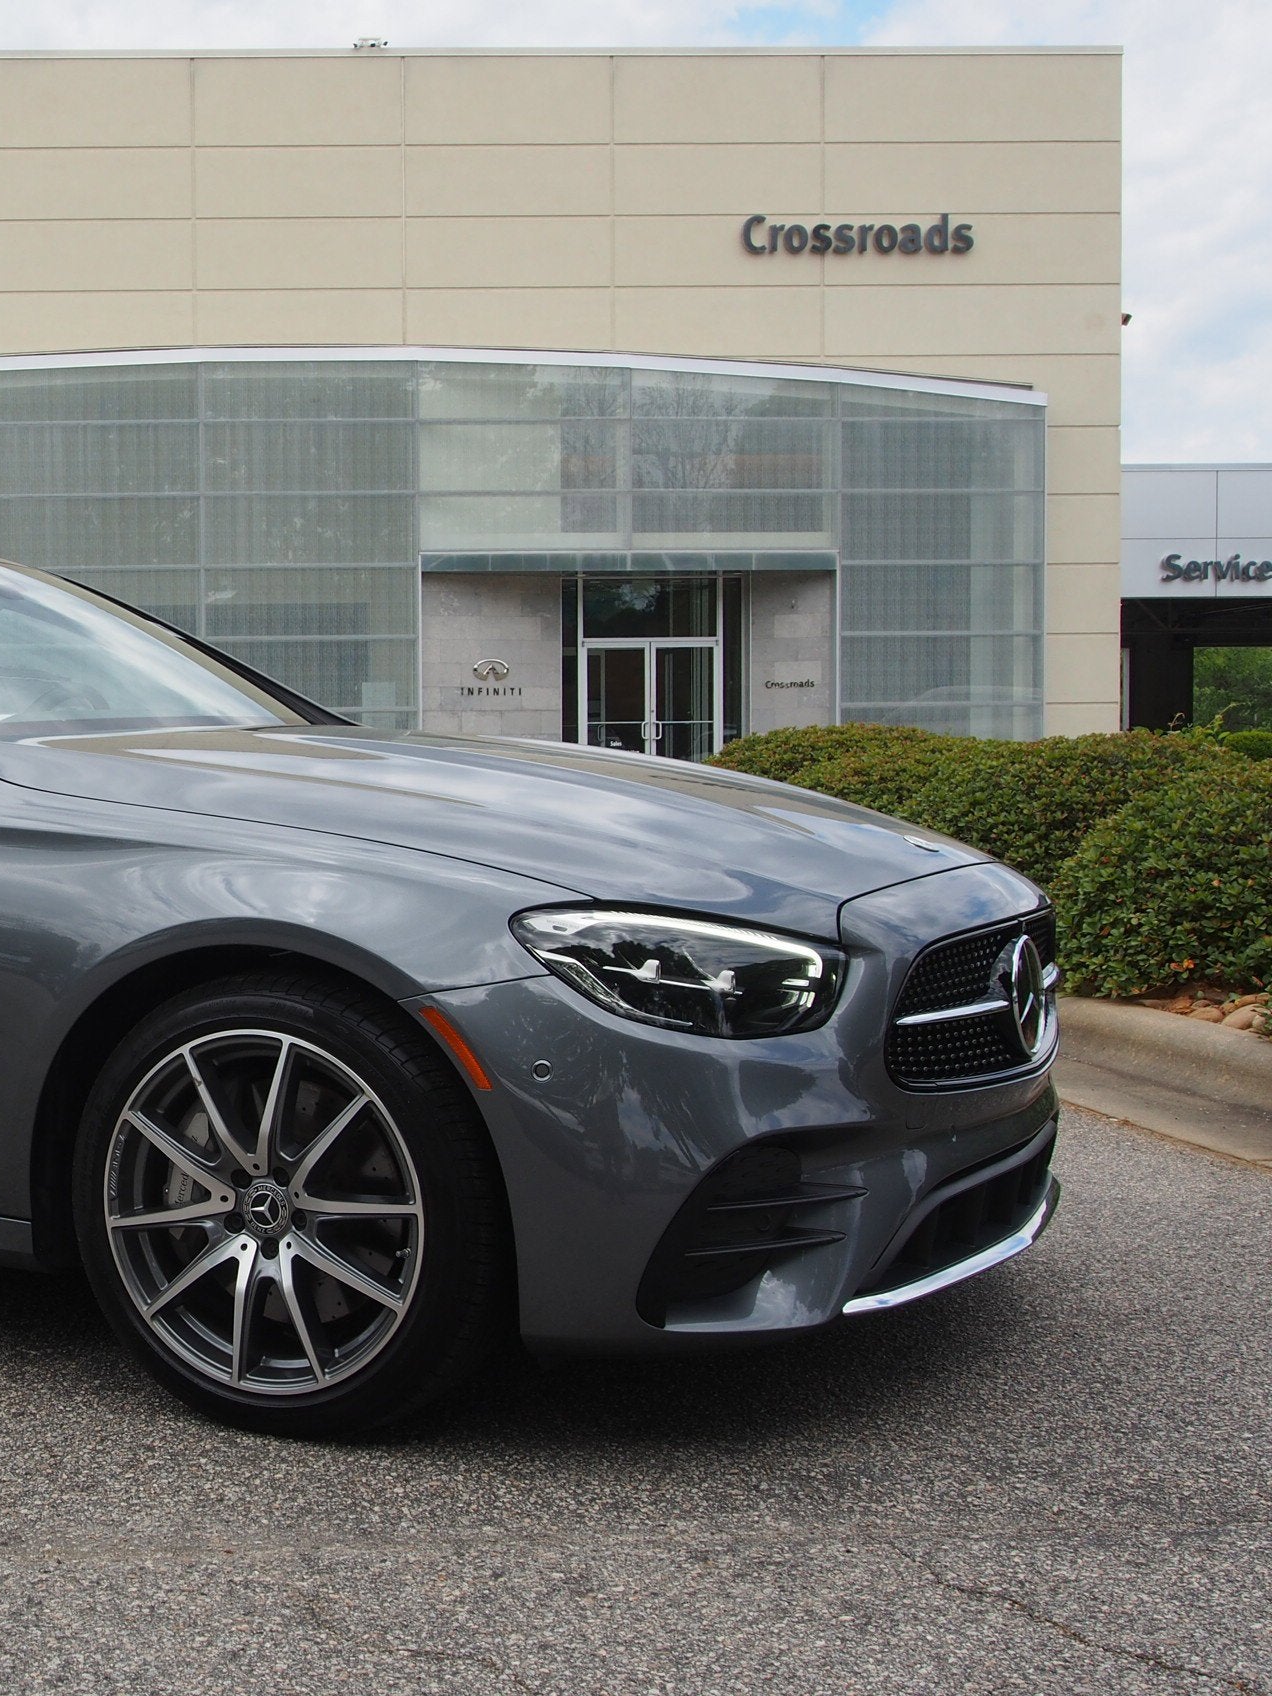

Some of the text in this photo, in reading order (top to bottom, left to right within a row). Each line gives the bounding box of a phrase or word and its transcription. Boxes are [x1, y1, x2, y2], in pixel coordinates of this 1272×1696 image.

[741, 213, 975, 254] Crossroads
[1161, 553, 1272, 583] Service
[460, 687, 522, 697] INFINITI
